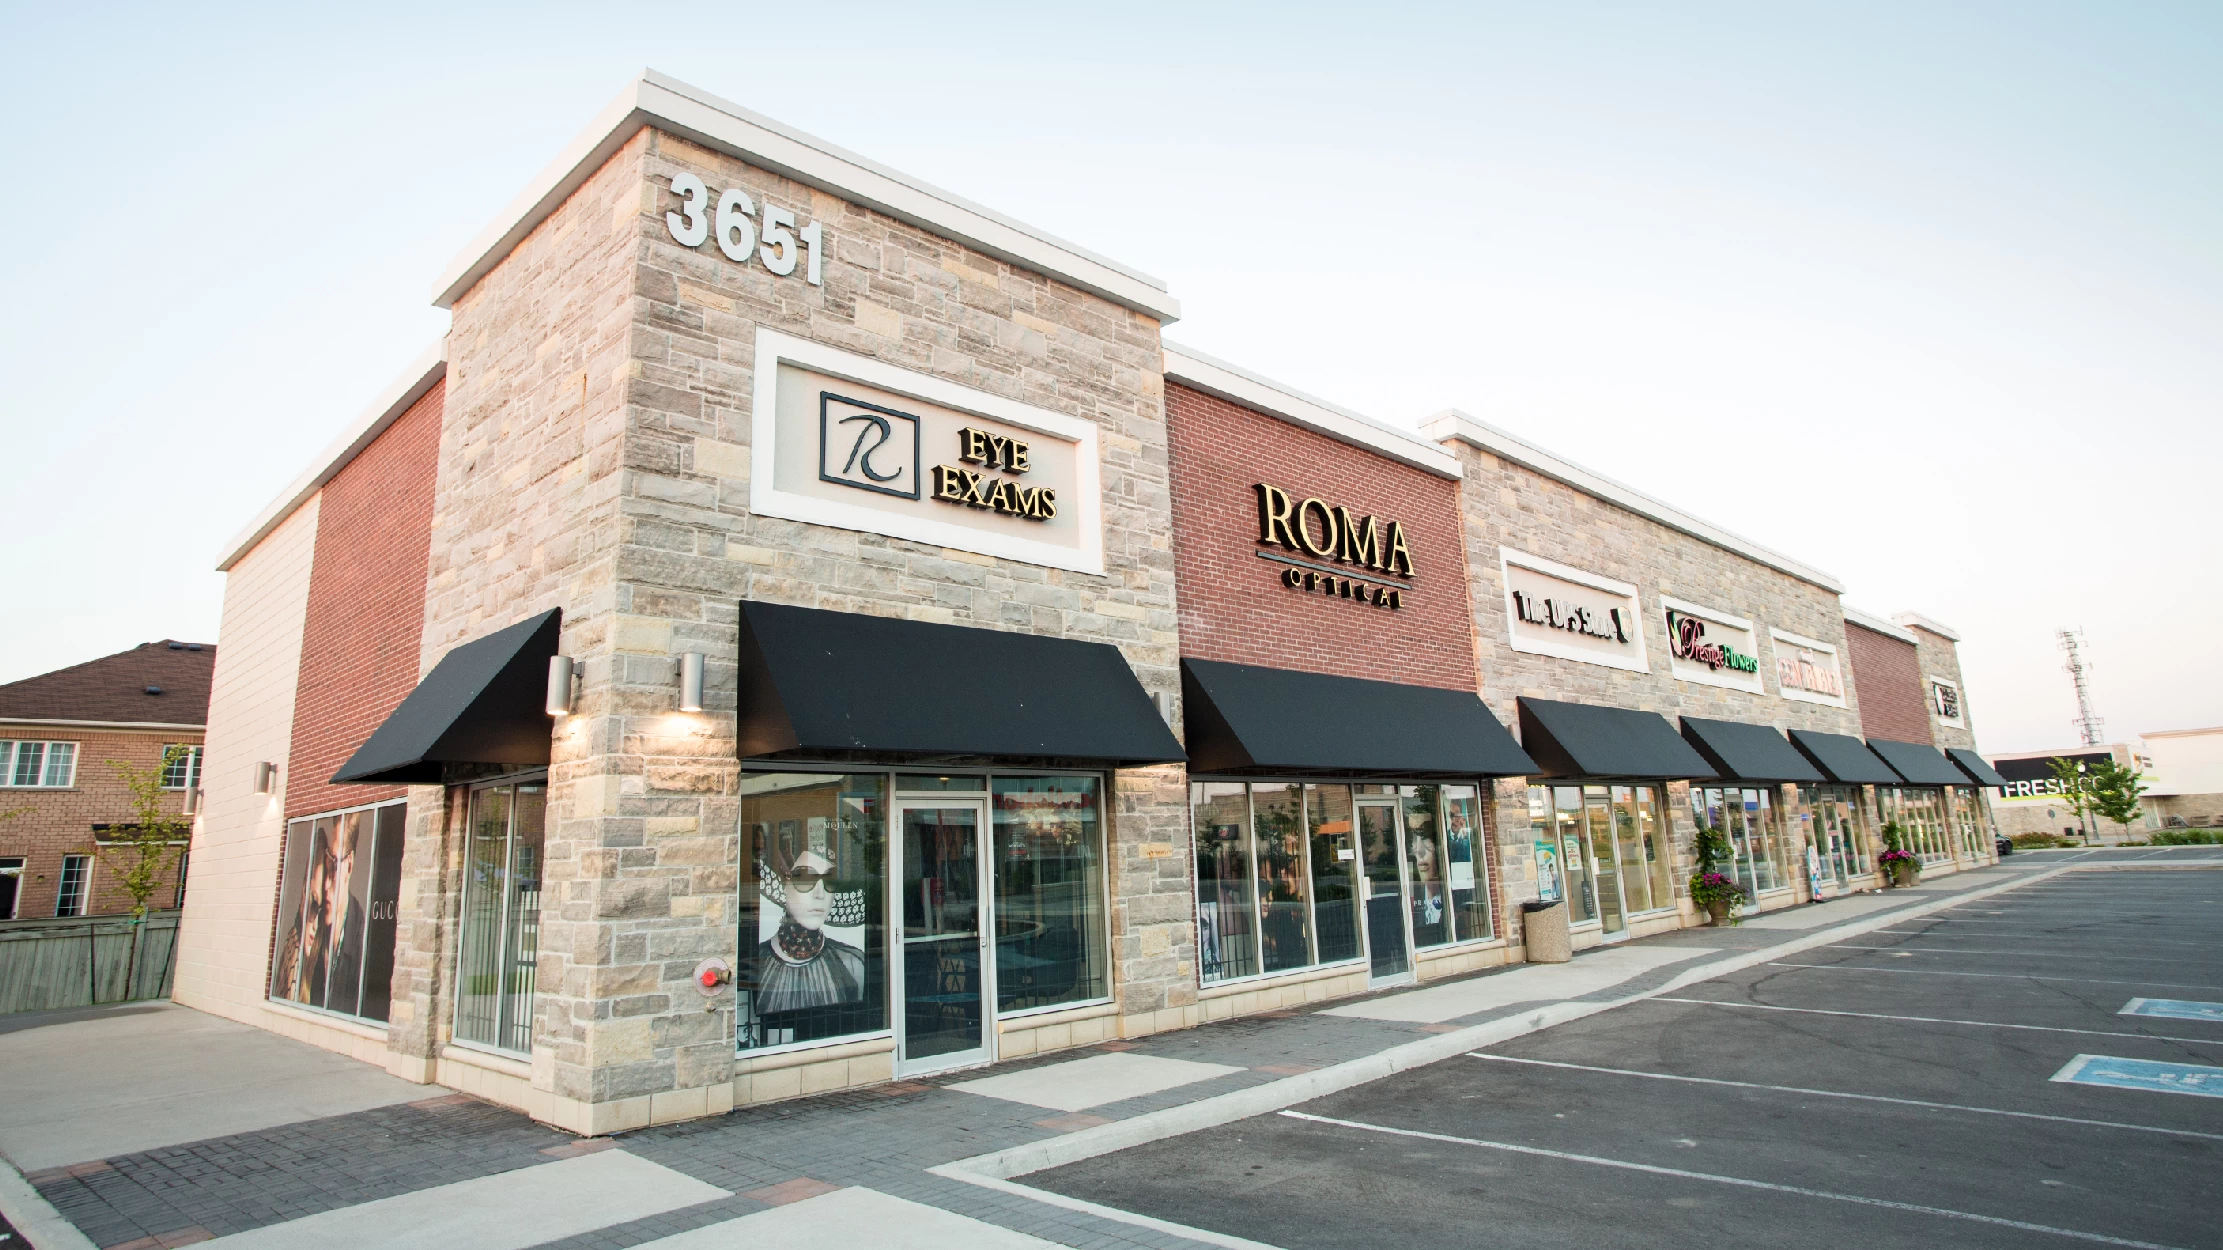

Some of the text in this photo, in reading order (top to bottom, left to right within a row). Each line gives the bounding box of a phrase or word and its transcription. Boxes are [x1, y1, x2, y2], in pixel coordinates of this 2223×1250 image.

[666, 172, 822, 286] 3651
[839, 414, 902, 482] R
[958, 427, 1031, 474] EYE
[931, 465, 1057, 521] EXAMS
[1252, 483, 1418, 578] ROMA
[1281, 567, 1405, 609] OPTICAL
[1512, 590, 1551, 623] The
[1546, 597, 1583, 632] UPS
[1580, 605, 1618, 640] Store
[1680, 617, 1724, 670] Prestige
[1722, 643, 1758, 673] Flowers
